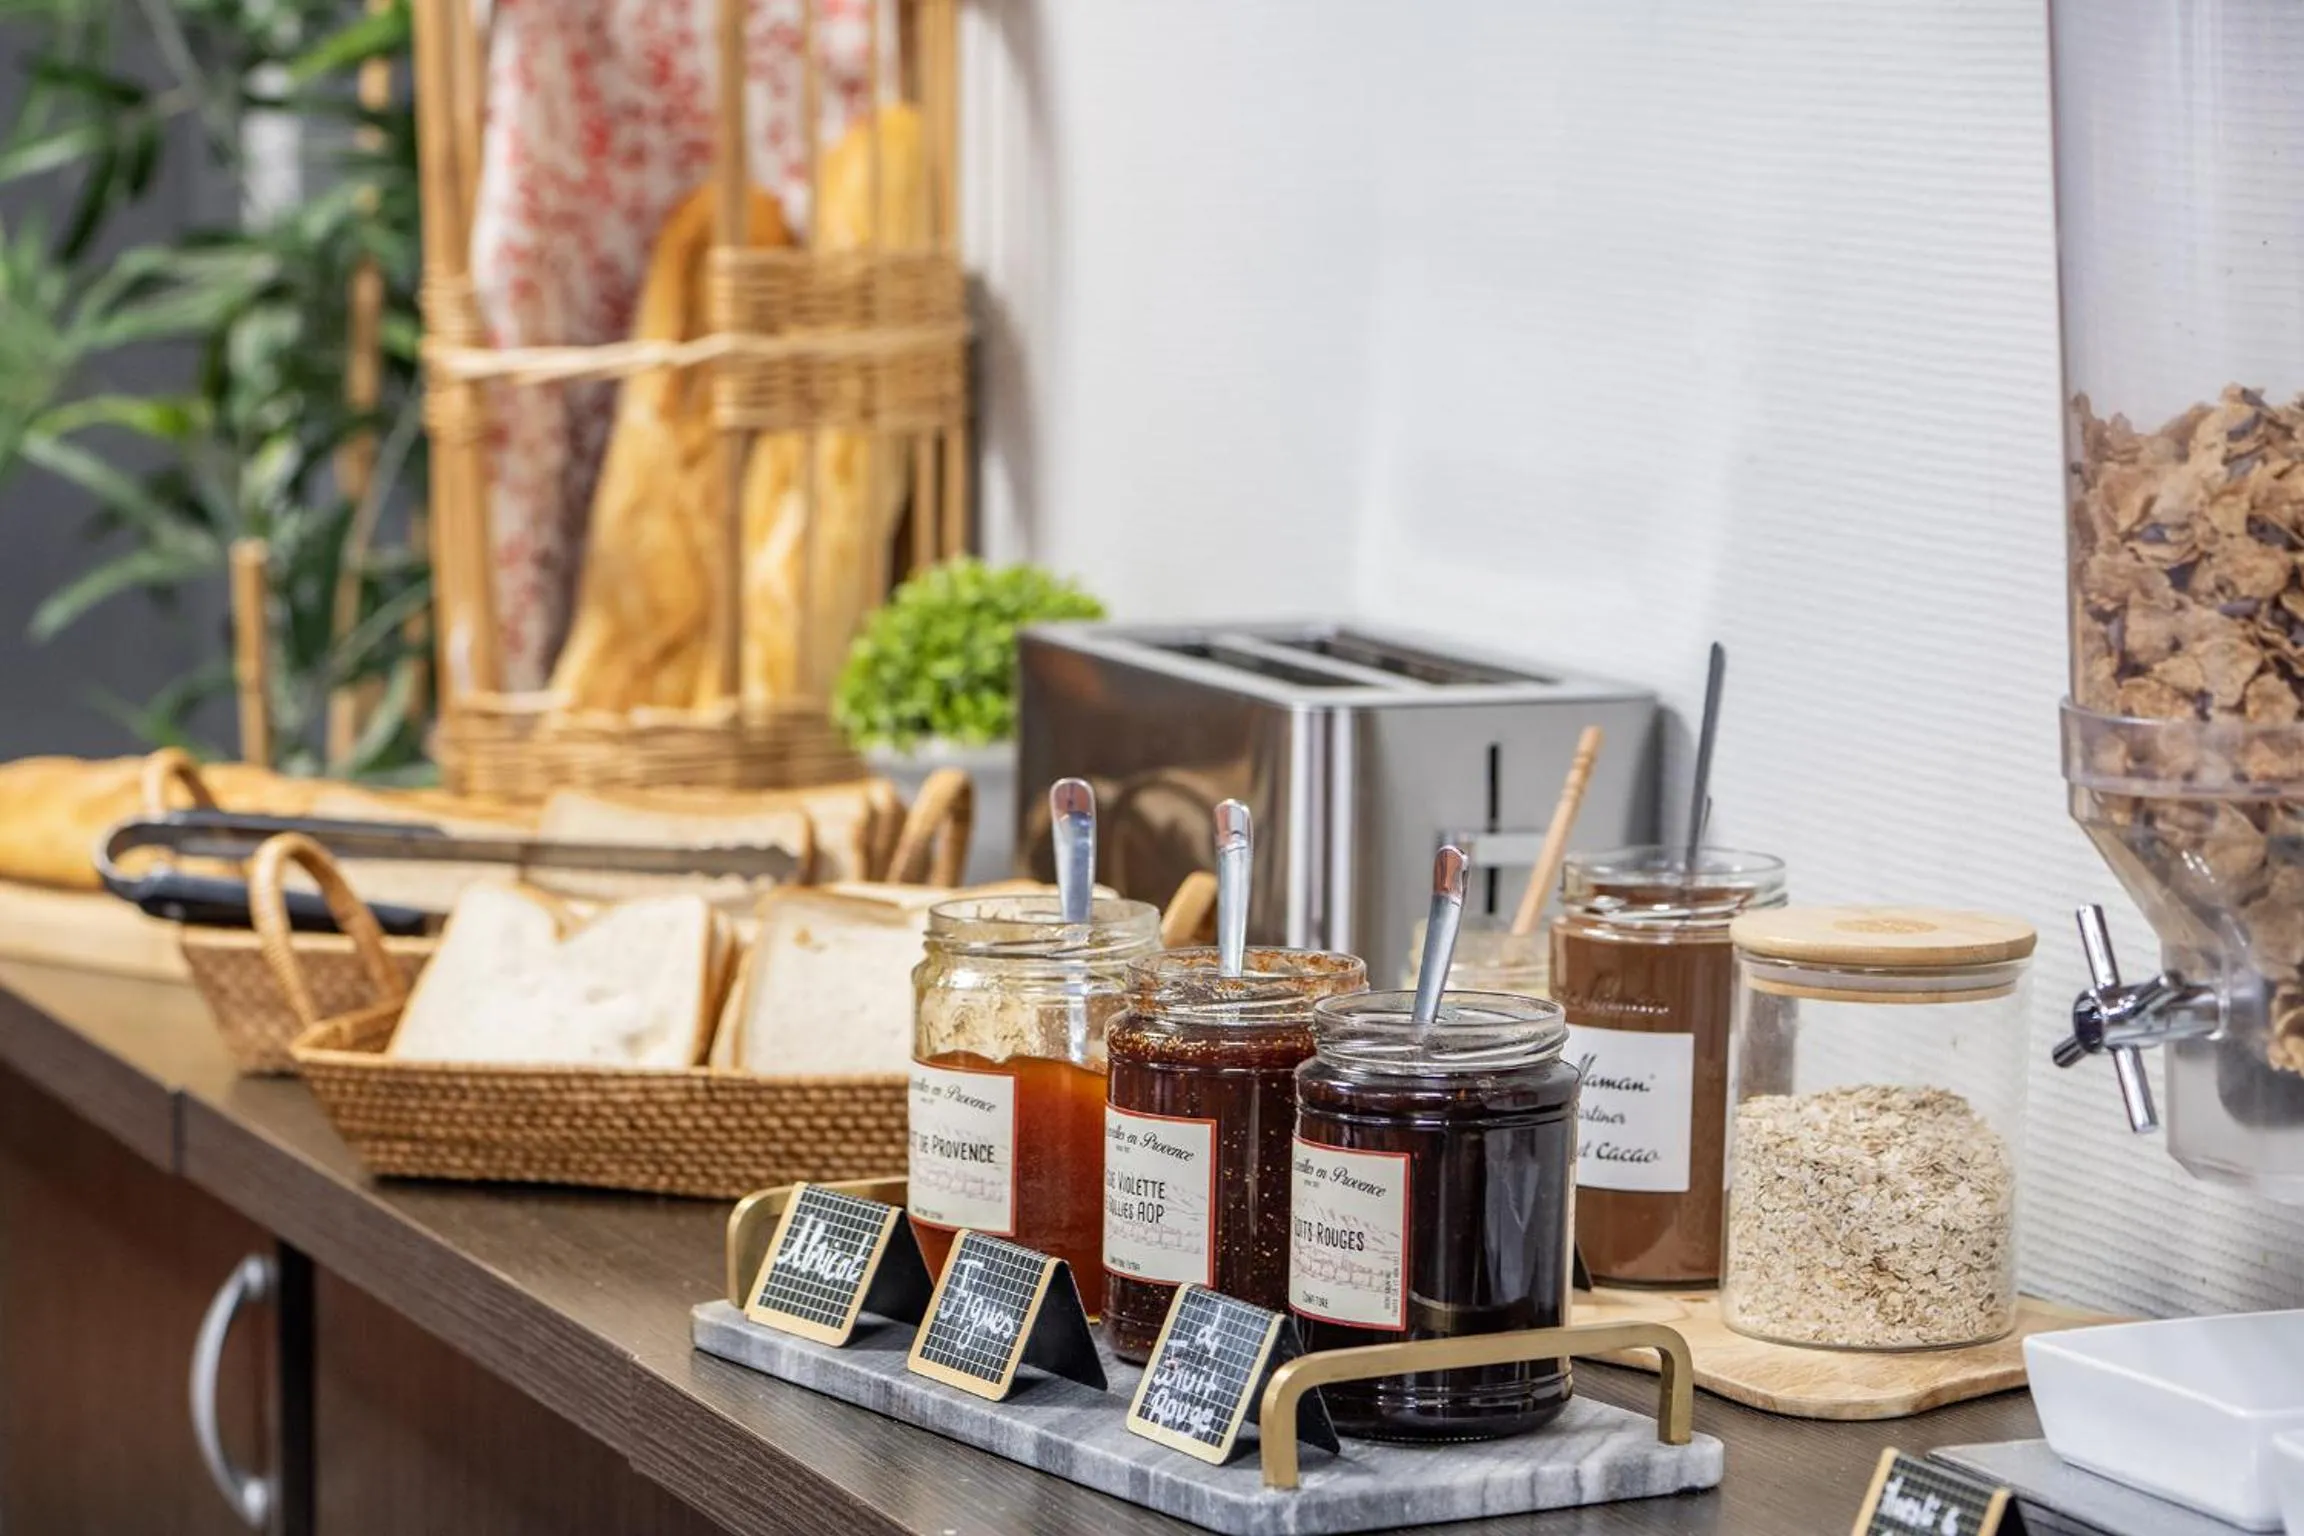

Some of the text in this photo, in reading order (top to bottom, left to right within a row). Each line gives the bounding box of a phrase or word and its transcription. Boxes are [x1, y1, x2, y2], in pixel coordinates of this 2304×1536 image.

[944, 1084, 997, 1114] Provence
[932, 1134, 995, 1164] PROVENCE
[1140, 1131, 1195, 1162] Provence
[1596, 1141, 1660, 1164] Cacao
[1118, 1170, 1166, 1200] VIOLETTE
[1329, 1165, 1387, 1198] Provence
[1137, 1201, 1165, 1224] AOP
[1317, 1222, 1365, 1252] ROUGES
